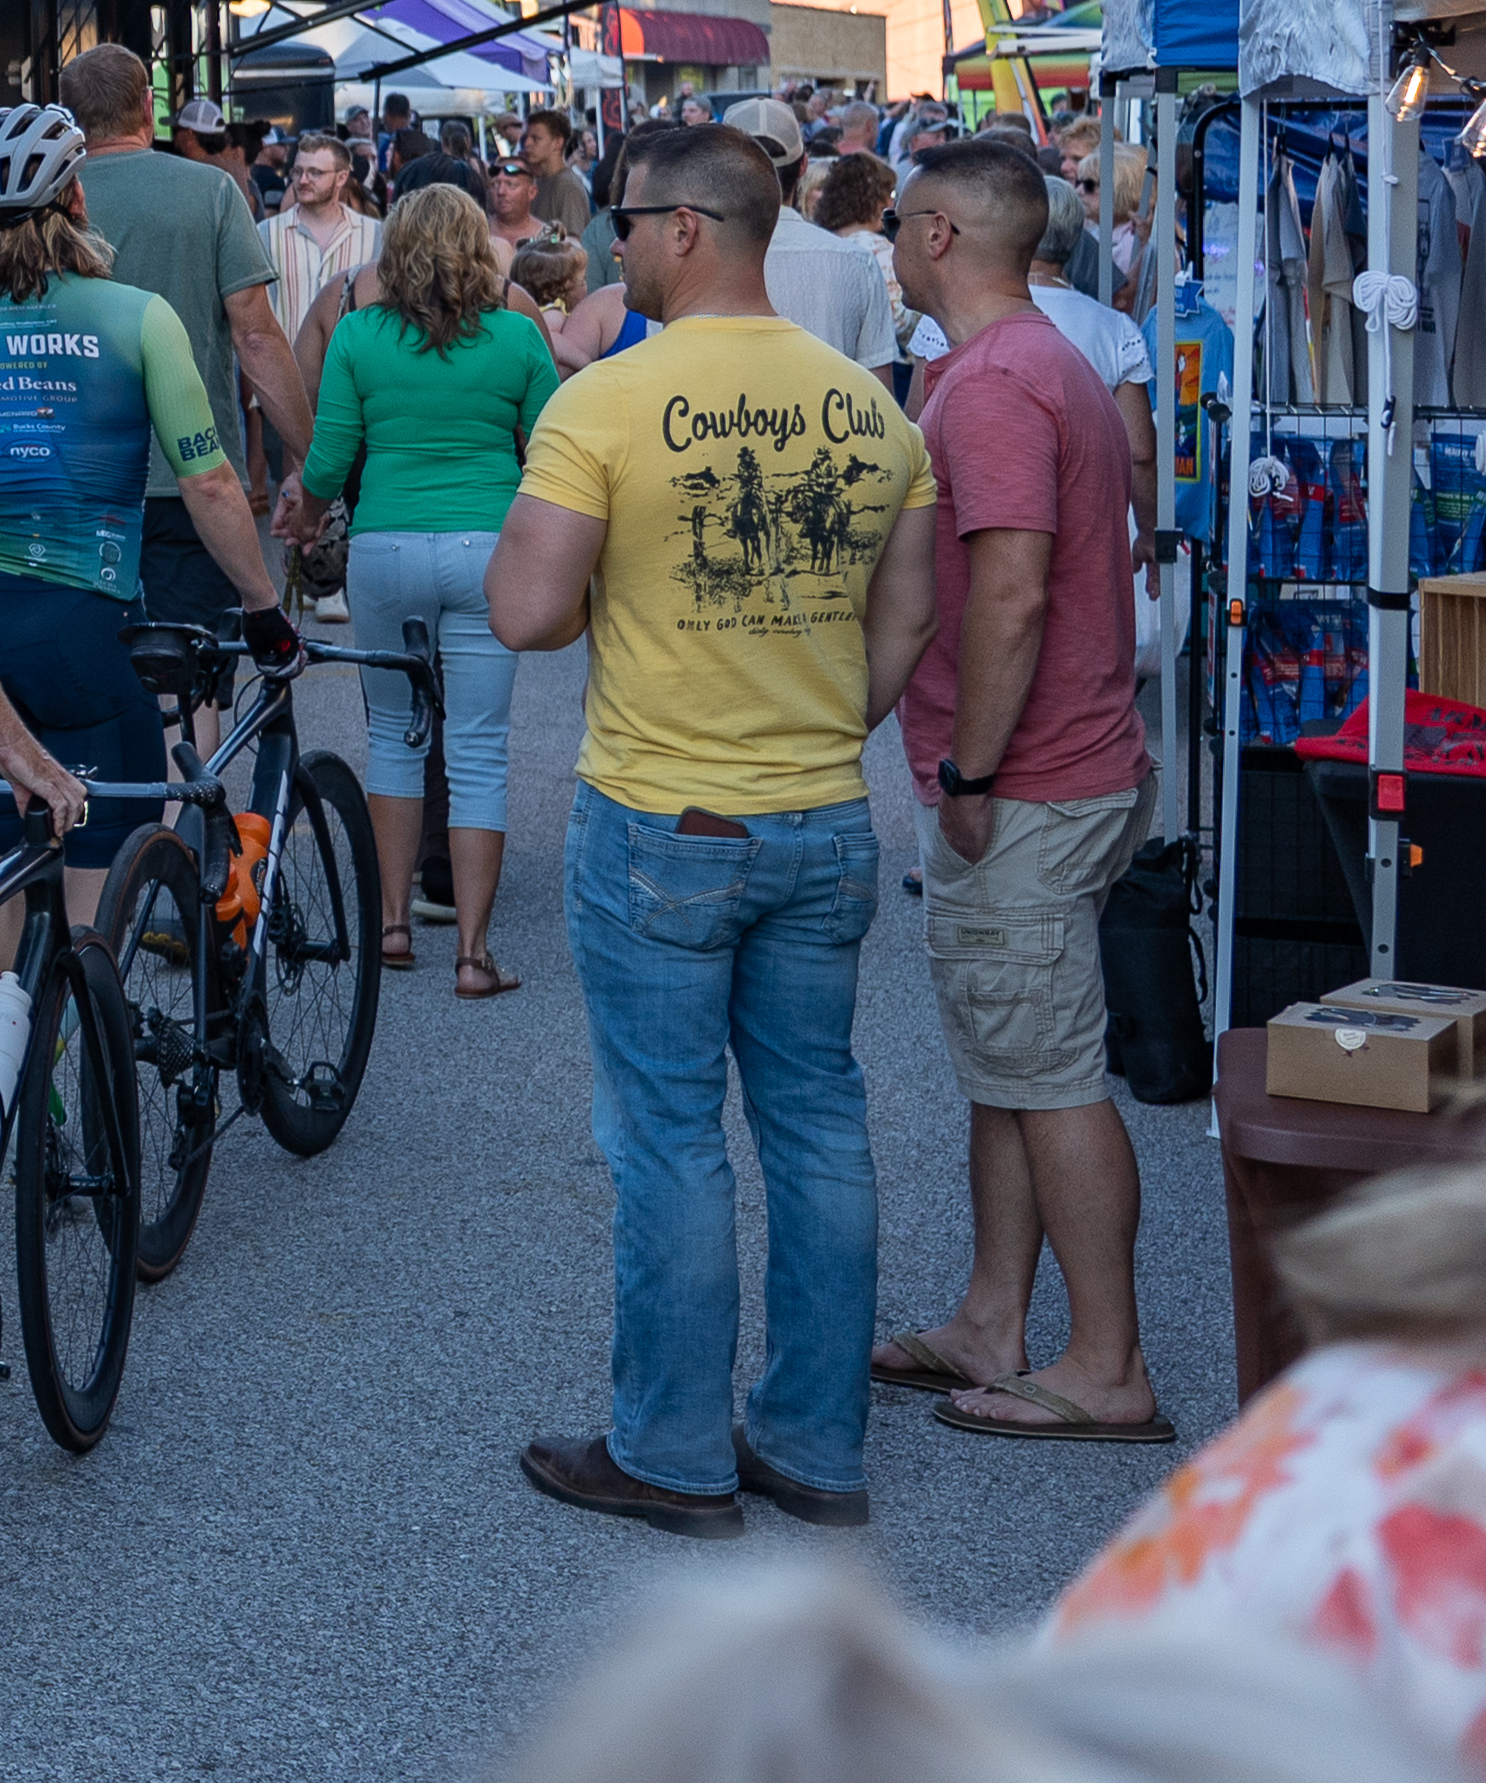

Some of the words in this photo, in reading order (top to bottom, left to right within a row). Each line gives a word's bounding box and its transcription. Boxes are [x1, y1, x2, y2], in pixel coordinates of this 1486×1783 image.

[6, 333, 100, 359] WORKS
[37, 360, 48, 369] BY
[17, 376, 77, 393] Beans
[42, 395, 78, 404] GROUP
[662, 393, 806, 453] Cowboys
[822, 388, 885, 444] Club
[177, 426, 217, 450] BAC
[10, 446, 51, 459] nyco
[677, 618, 711, 632] ONLY
[716, 617, 736, 631] GOD
[741, 614, 766, 627] CAN
